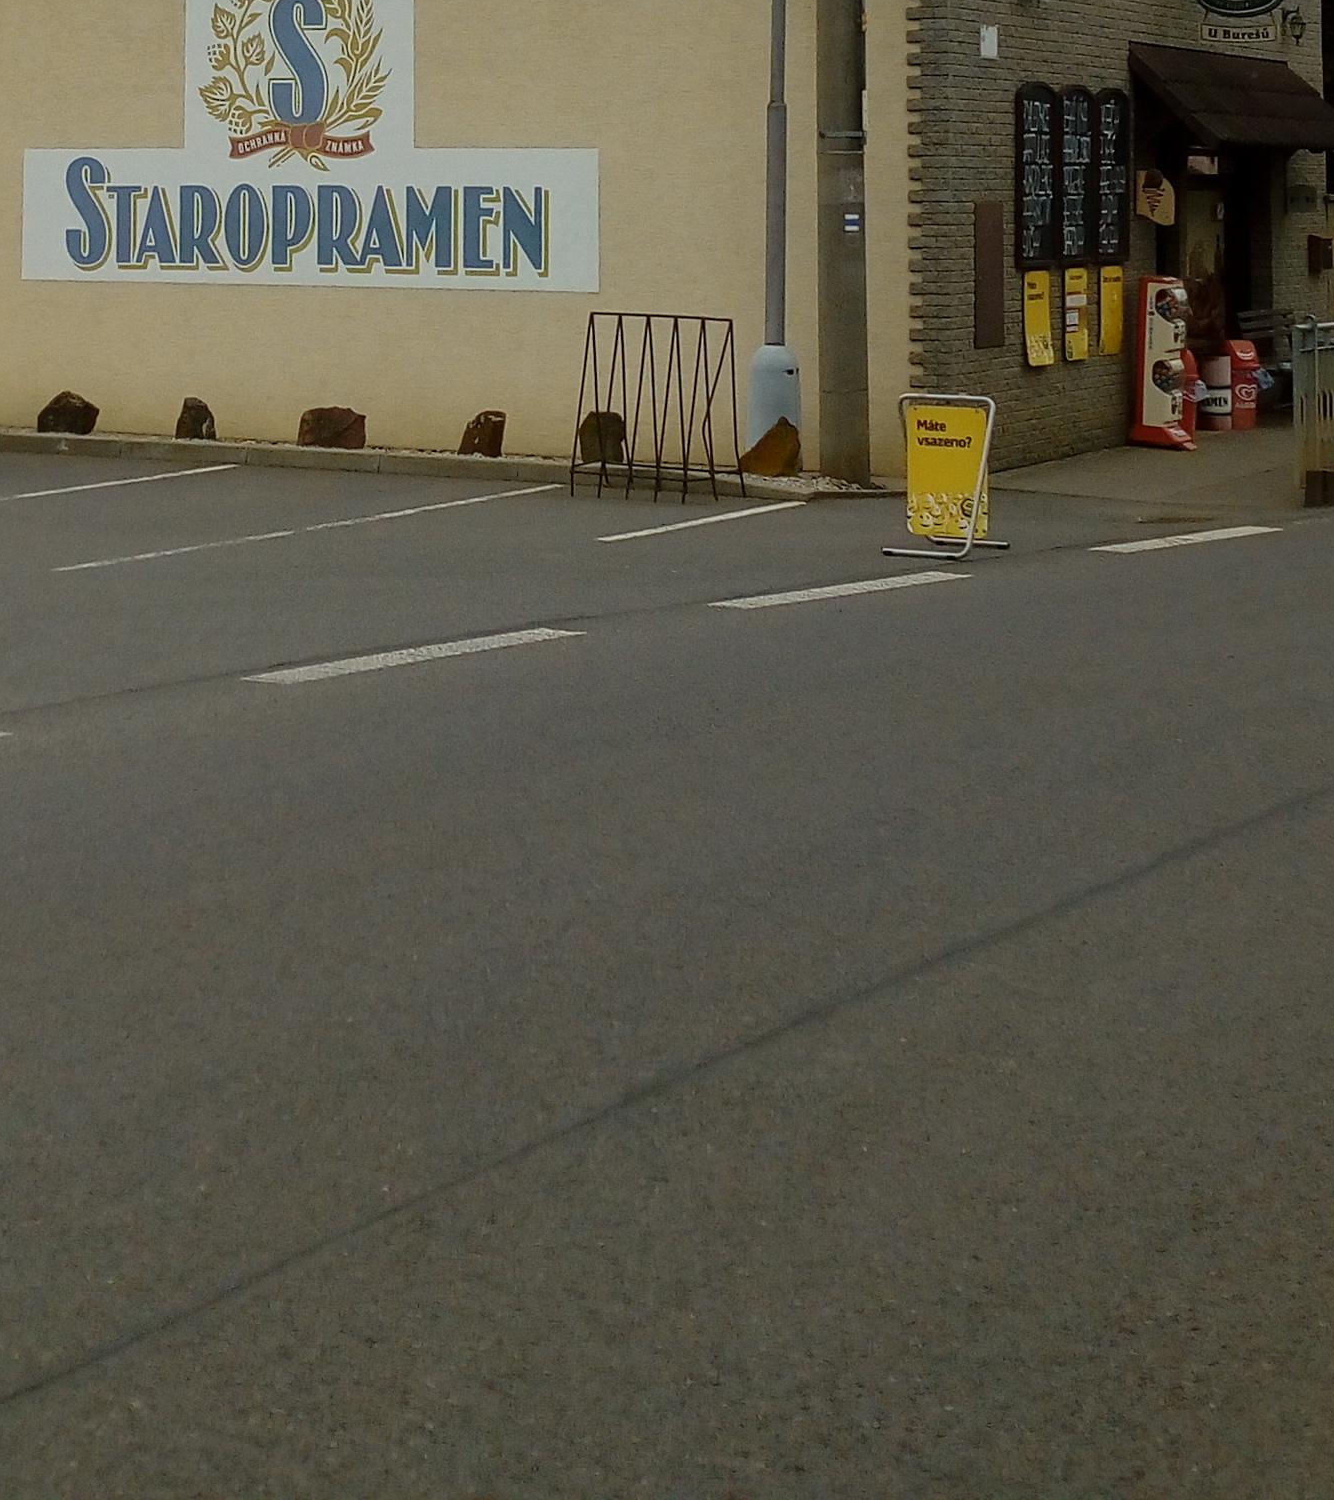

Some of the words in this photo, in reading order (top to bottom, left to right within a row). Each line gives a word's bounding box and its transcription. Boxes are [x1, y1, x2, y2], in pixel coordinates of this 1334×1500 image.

[1208, 28, 1217, 38] U
[325, 139, 364, 154] ZNÁMKA
[65, 157, 549, 277] STAROPRAMEN
[917, 419, 947, 432] Máte
[917, 436, 972, 448] vsazeno?
